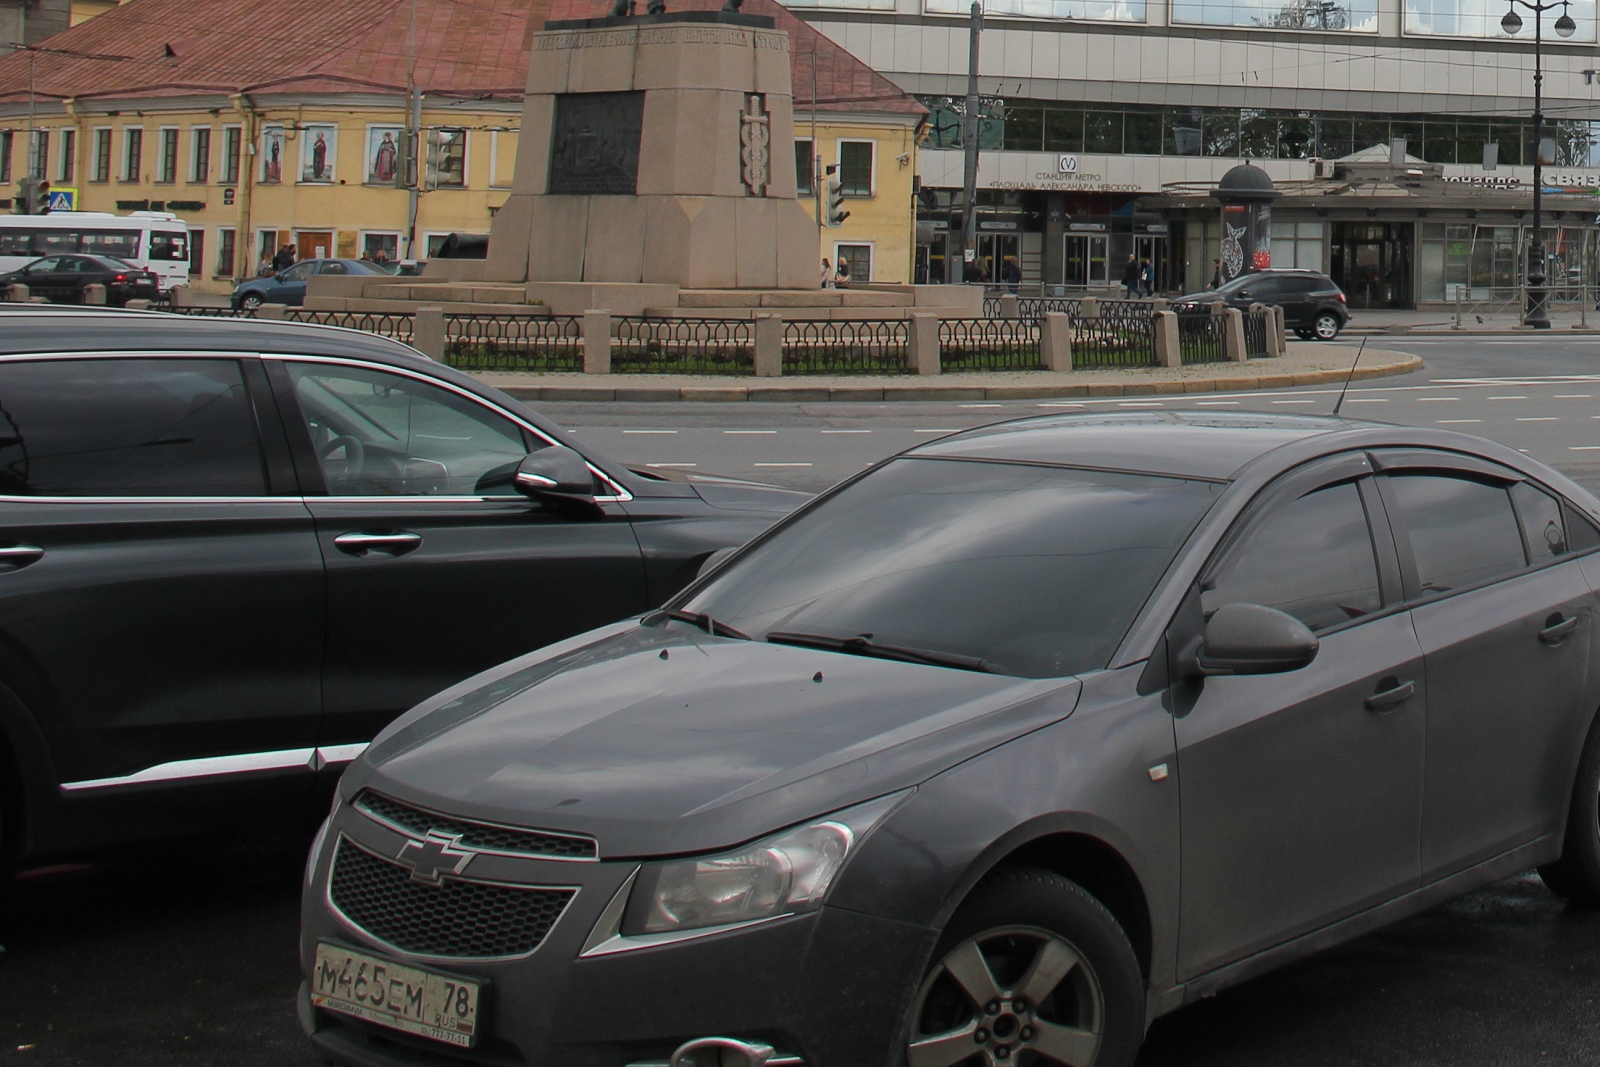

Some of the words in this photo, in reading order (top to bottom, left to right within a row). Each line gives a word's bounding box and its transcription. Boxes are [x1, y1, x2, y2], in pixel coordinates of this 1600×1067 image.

[1036, 172, 1072, 181] СТАНЦИЯ
[1075, 173, 1101, 181] МЕТРО
[1040, 183, 1094, 191] АЛЕКСАНДРА
[320, 957, 423, 1018] М465ЕМ
[443, 981, 470, 1018] 78
[436, 1013, 457, 1030] RUS
